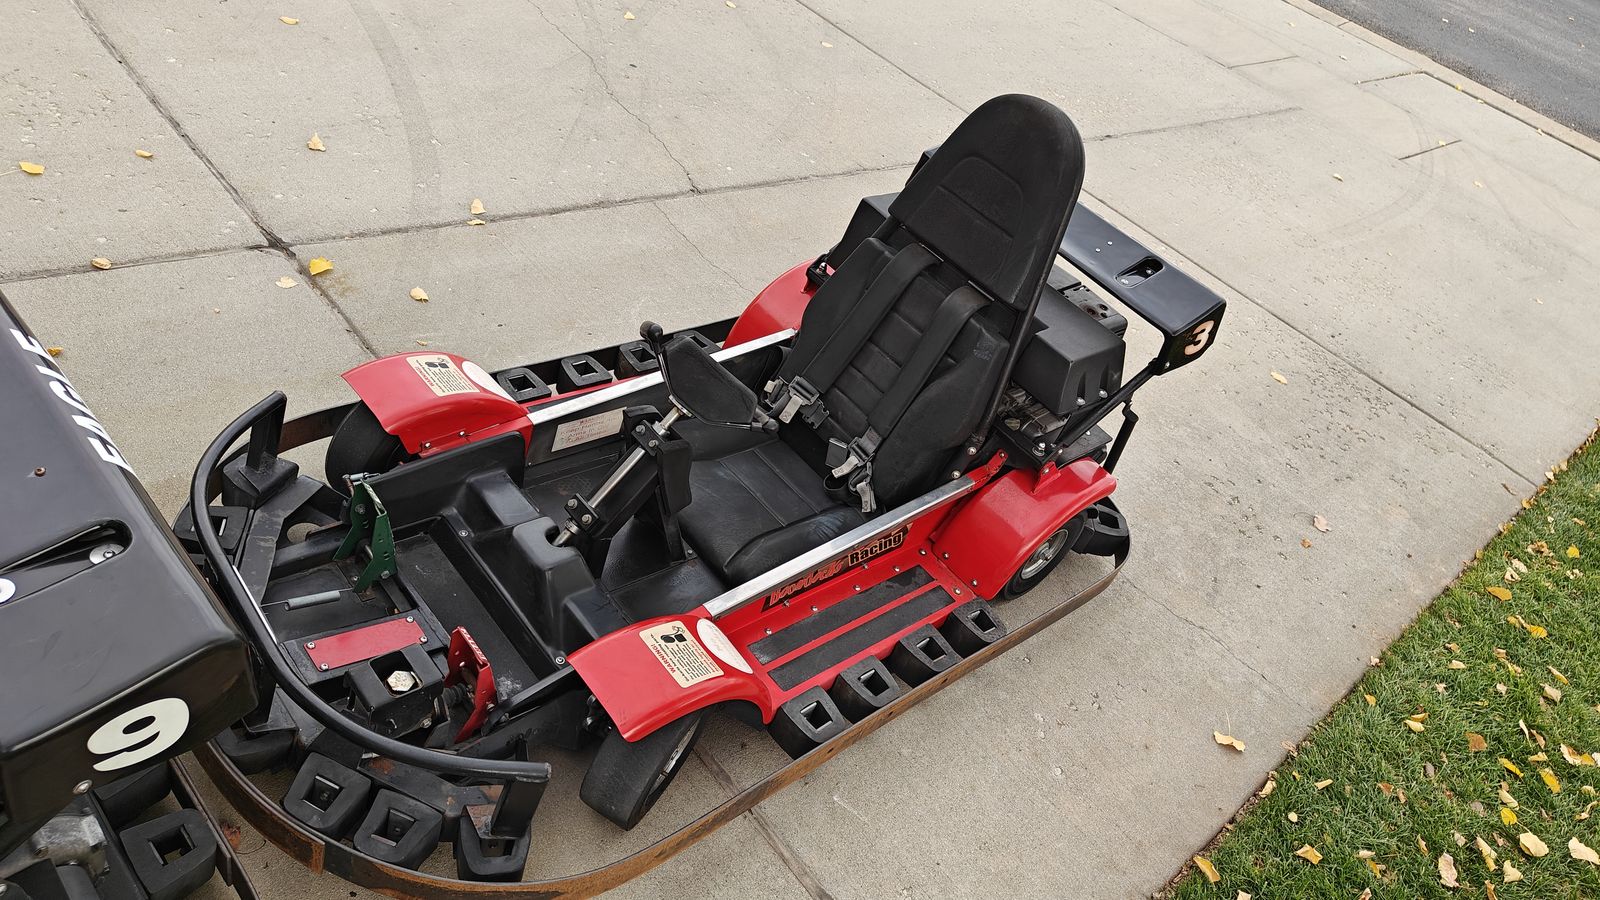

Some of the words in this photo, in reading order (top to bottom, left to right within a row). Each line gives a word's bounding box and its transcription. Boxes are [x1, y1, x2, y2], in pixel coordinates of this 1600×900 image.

[1184, 320, 1215, 355] 3
[9, 328, 135, 474] EAGLE
[848, 531, 903, 566] Racing
[650, 643, 676, 673] WARNING!
[87, 698, 189, 771] 9
